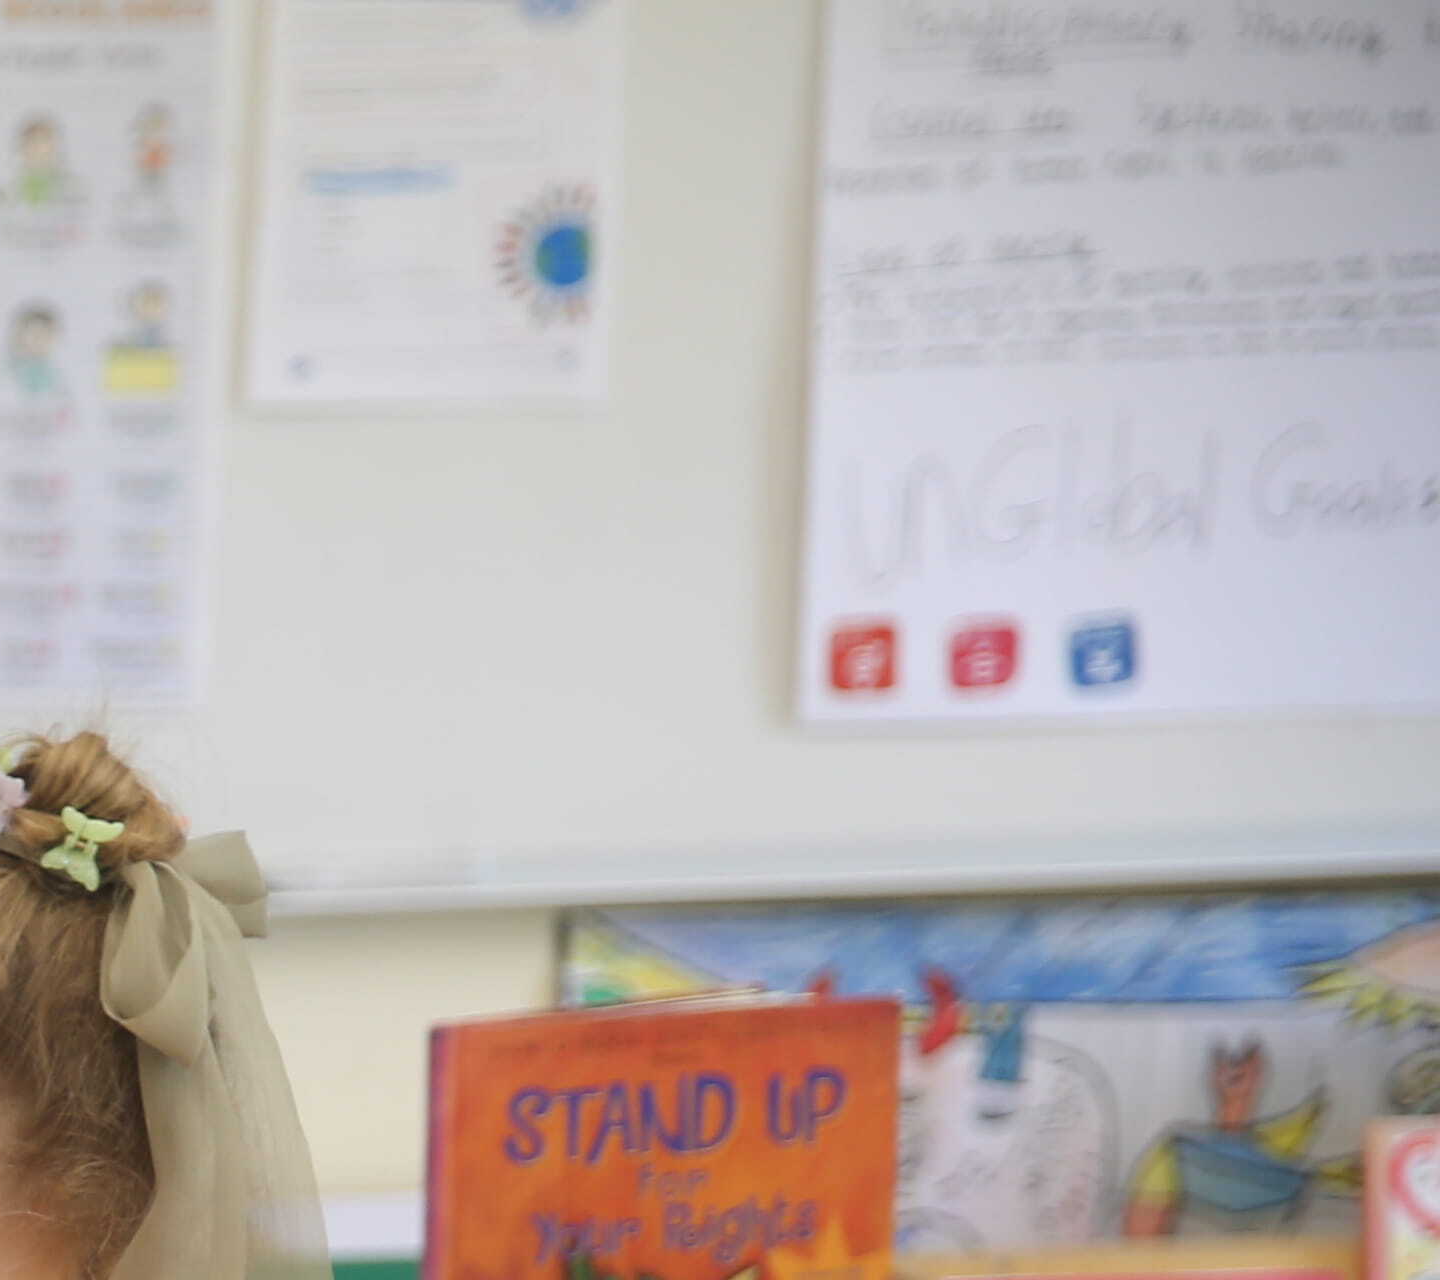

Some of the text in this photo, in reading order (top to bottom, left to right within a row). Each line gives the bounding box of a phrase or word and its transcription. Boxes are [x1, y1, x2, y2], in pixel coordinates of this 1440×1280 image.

[505, 1063, 847, 1166] STAND UP
[661, 1194, 818, 1265] Rights
